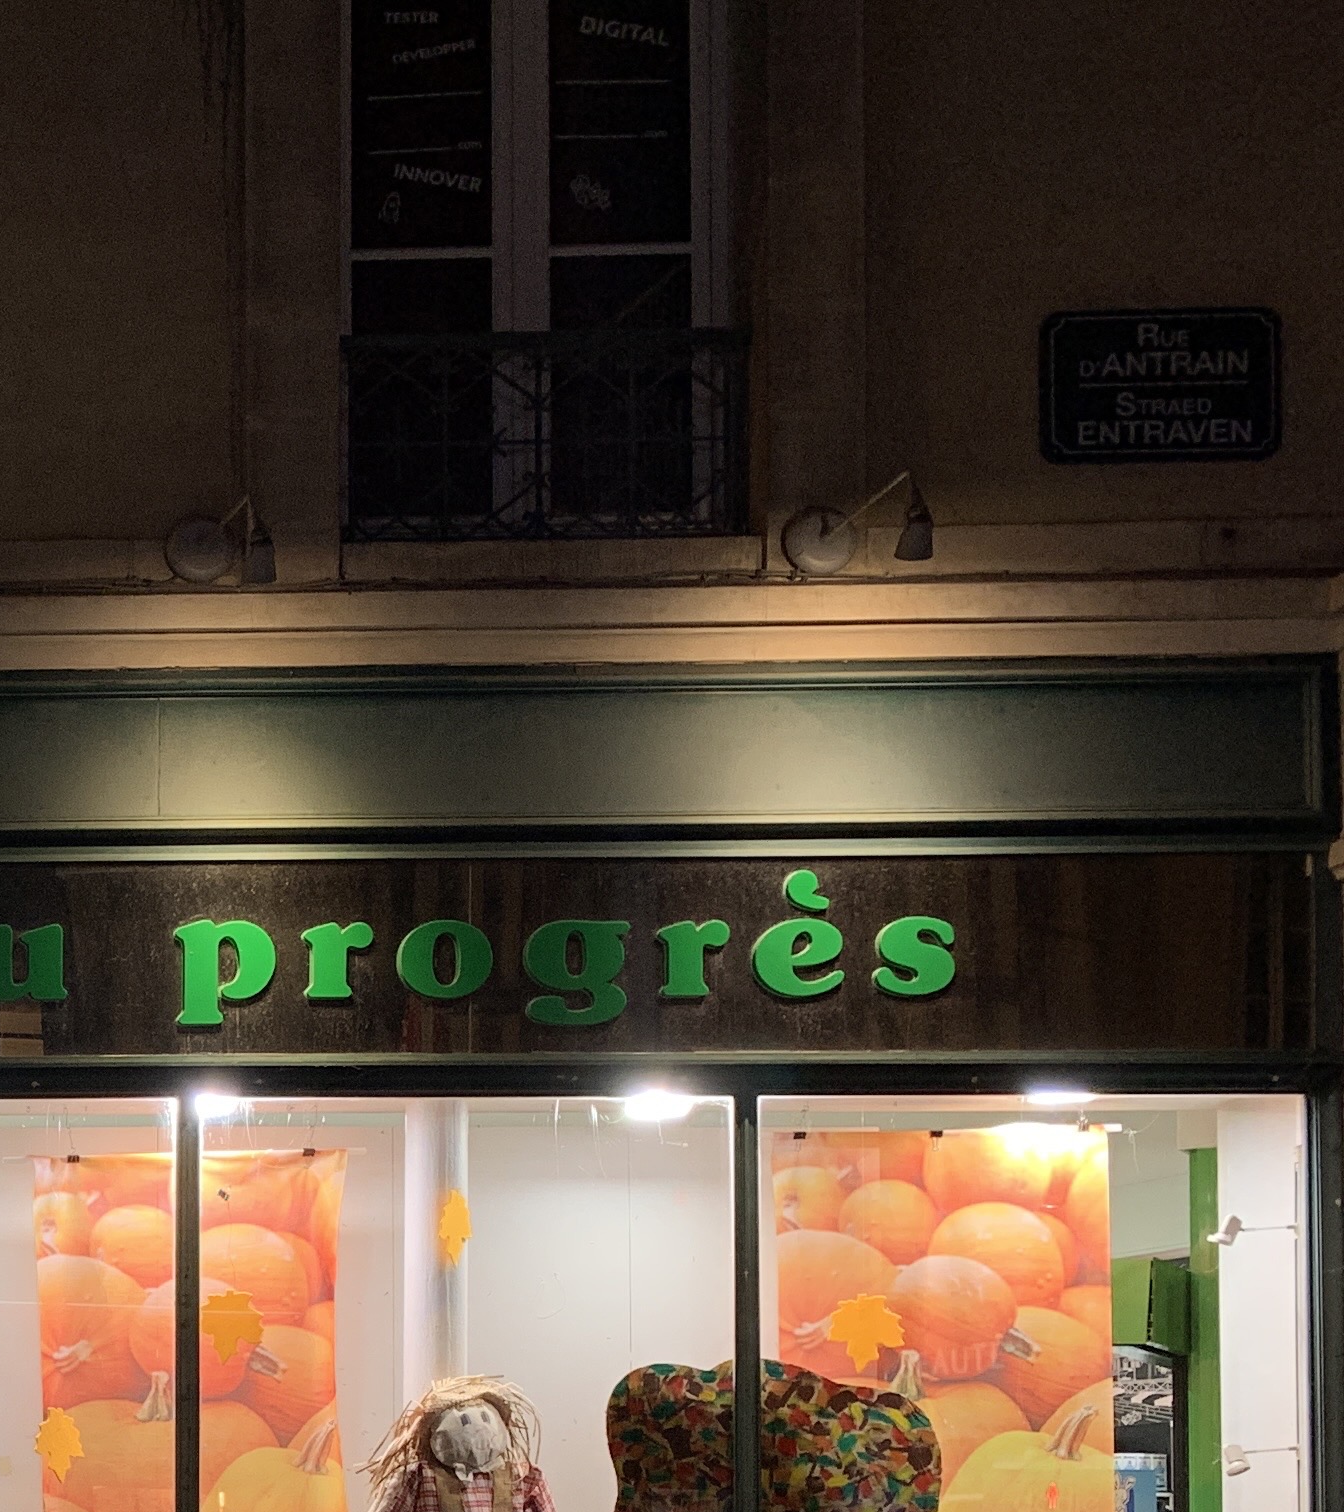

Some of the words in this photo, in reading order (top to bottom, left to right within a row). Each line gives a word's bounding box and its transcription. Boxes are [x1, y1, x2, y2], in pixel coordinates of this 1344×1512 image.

[579, 16, 670, 47] DIGITAL
[394, 164, 482, 192] INNOVER
[1077, 419, 1253, 445] ENTRAVEN
[175, 870, 961, 1026] progrès
